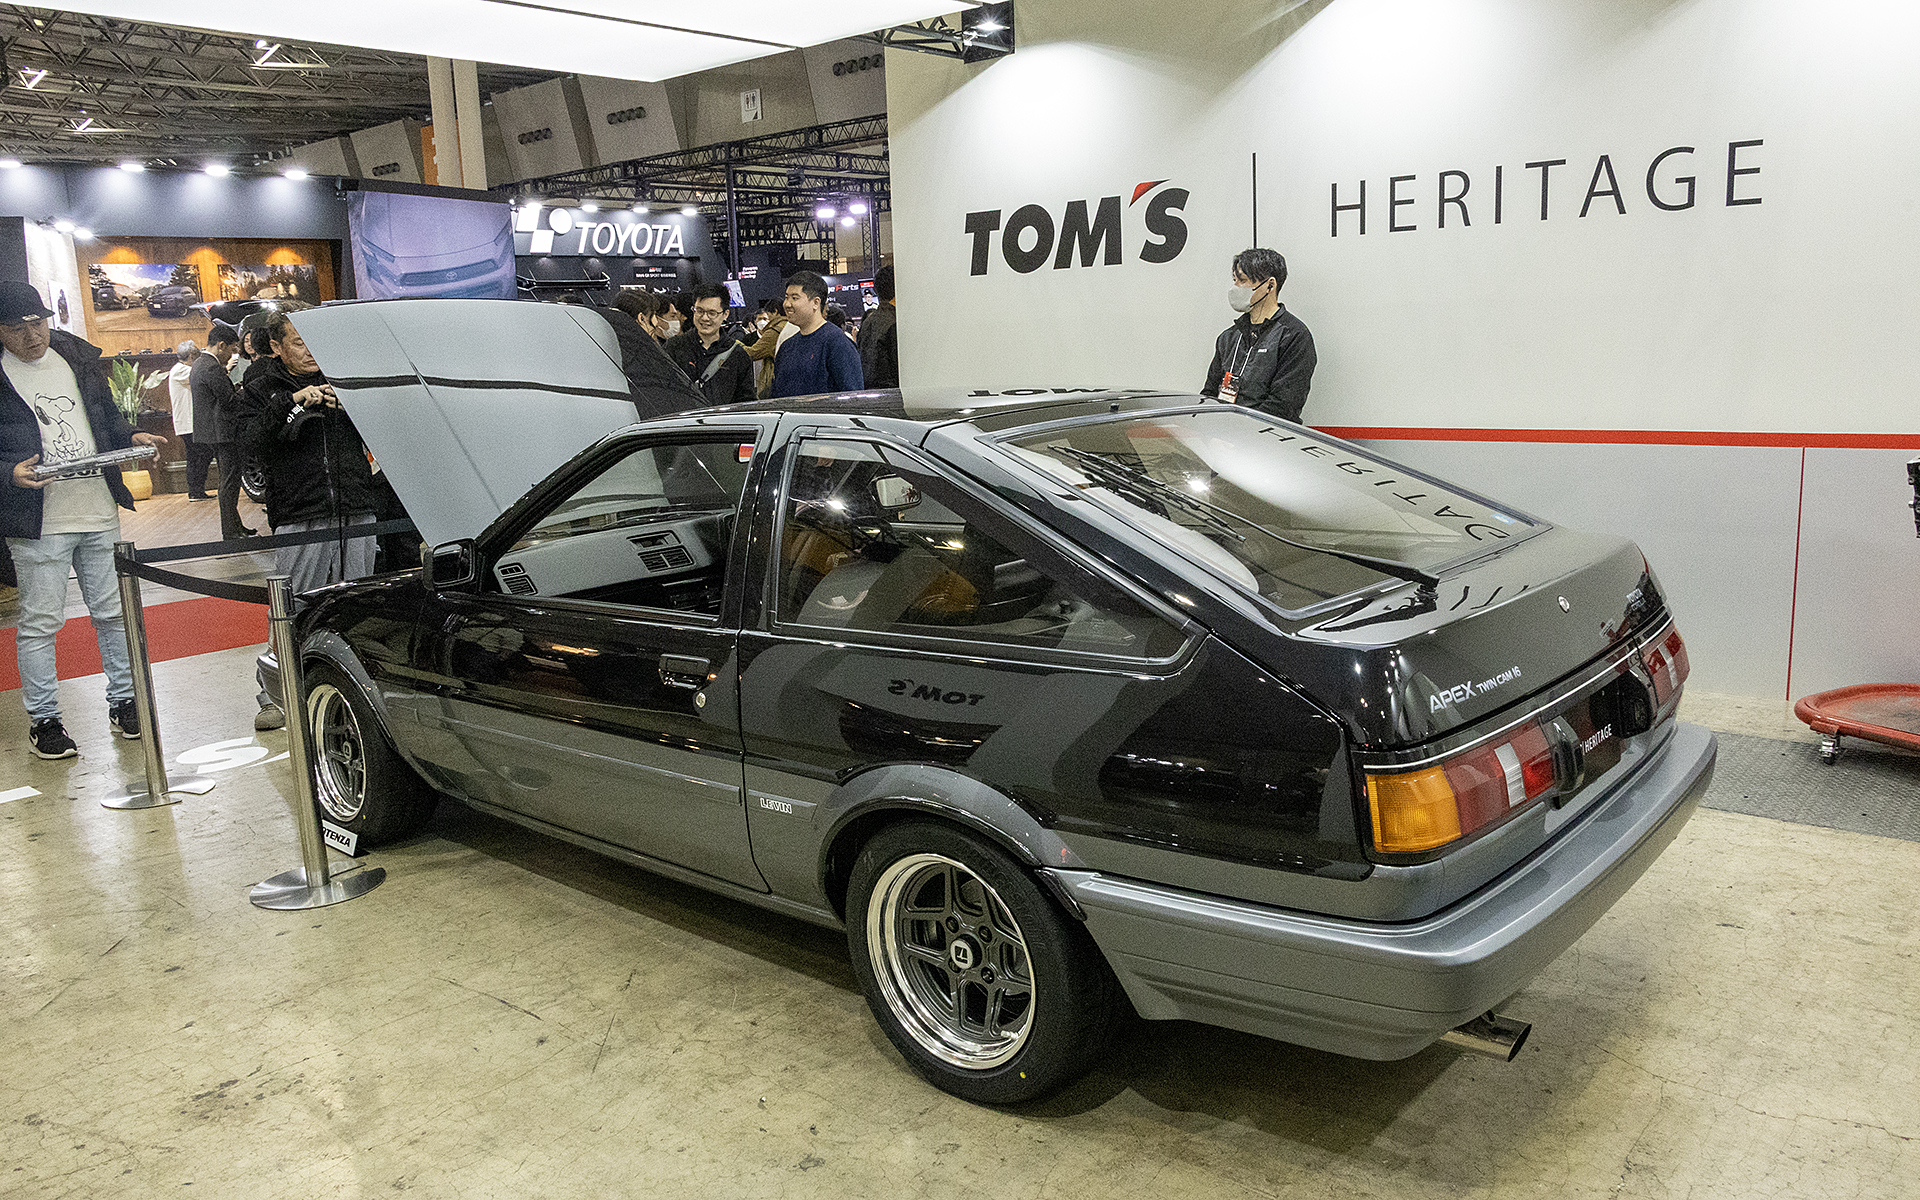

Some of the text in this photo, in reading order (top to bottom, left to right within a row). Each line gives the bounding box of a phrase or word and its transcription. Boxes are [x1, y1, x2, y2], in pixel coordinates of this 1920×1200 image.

[964, 138, 1765, 277] TOM'S HERITAGE
[575, 222, 685, 255] TOYOTA
[835, 284, 859, 292] Parts
[1429, 680, 1477, 713] APEX
[1476, 678, 1498, 694] TWIN
[1497, 670, 1514, 685] CAM
[1584, 723, 1613, 753] HERITAGE
[760, 797, 793, 814] LEVIN
